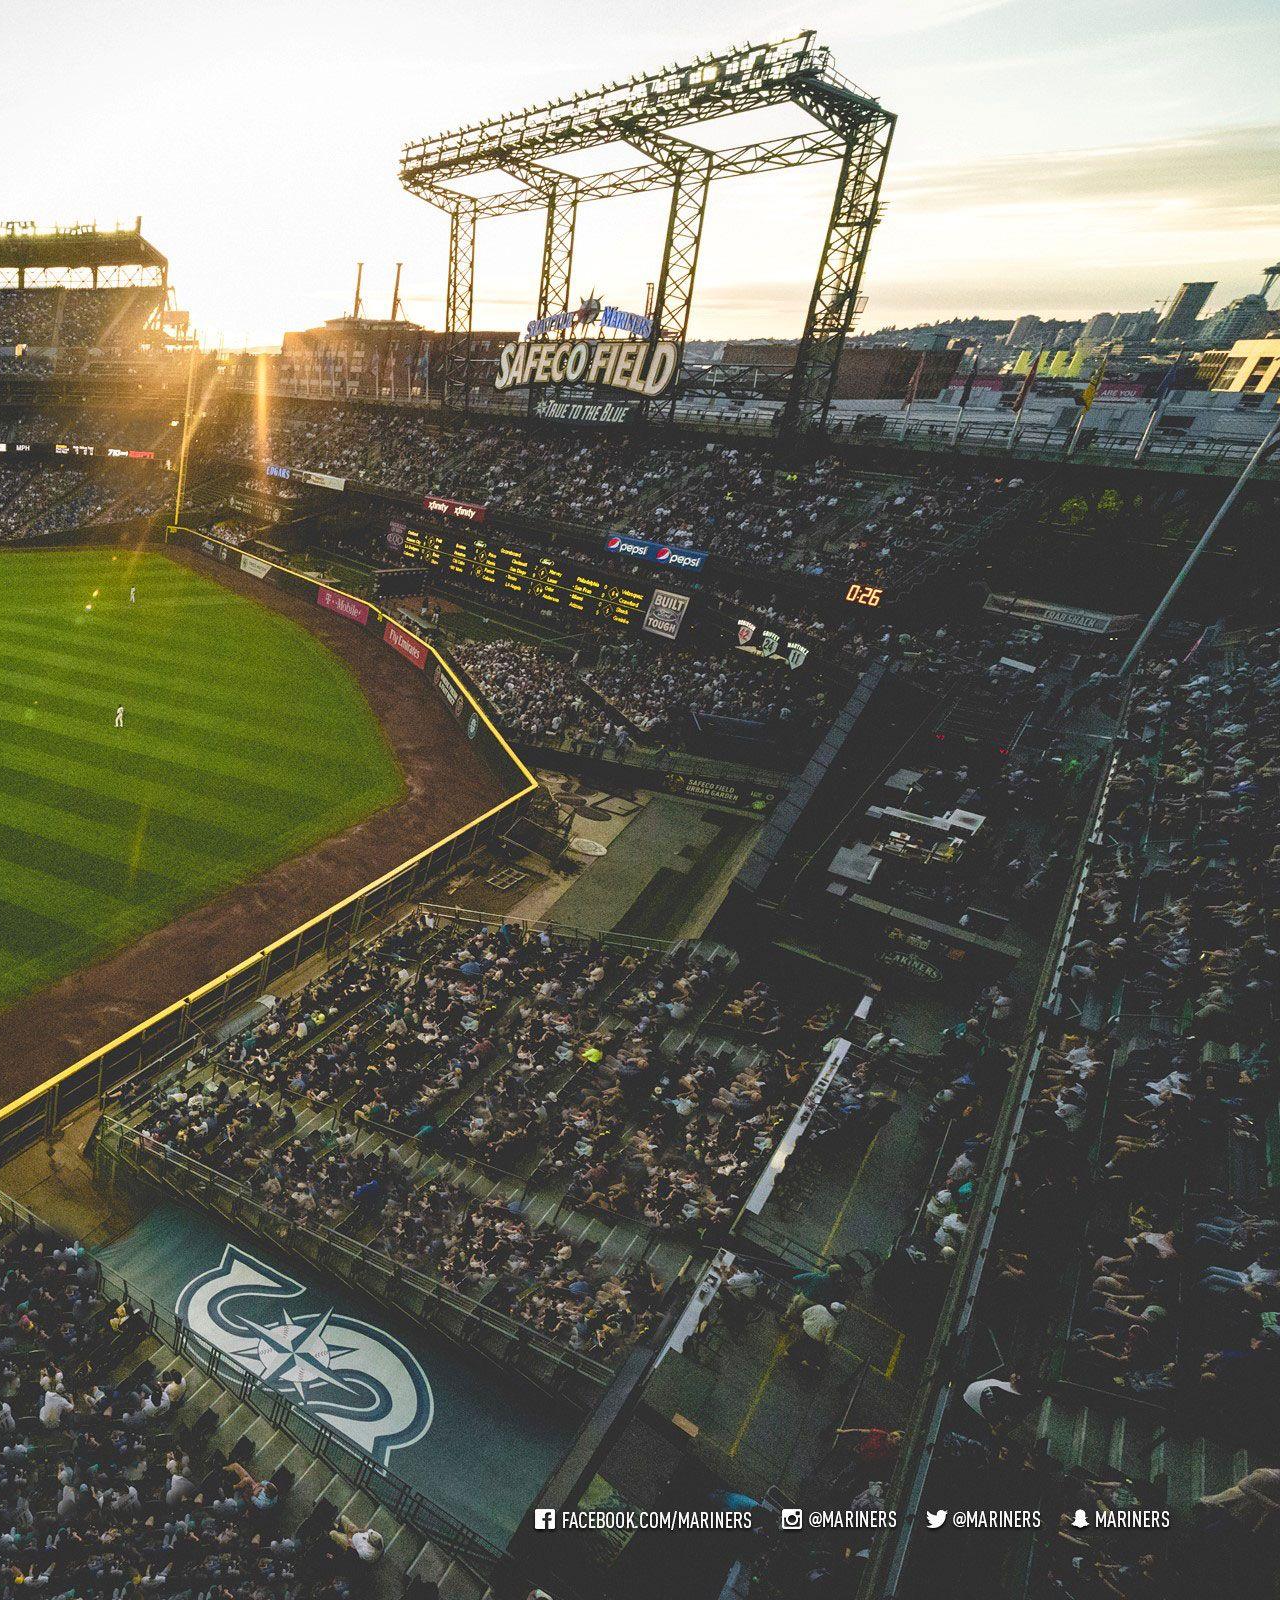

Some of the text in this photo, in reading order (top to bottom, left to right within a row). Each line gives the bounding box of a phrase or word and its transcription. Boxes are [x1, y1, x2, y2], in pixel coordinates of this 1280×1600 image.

[524, 306, 655, 341] SEATTLE MARINERS
[494, 341, 678, 396] SAFECO FIELD
[546, 400, 629, 423] TRUE TO THE BLUE
[129, 450, 155, 459] ESPN
[428, 500, 476, 520] xfinity xfinity
[619, 543, 701, 568] pepsi pepsi
[654, 594, 686, 612] BUILT
[845, 584, 883, 607] 0:26
[657, 610, 677, 621] Ford
[1067, 615, 1097, 628] SHACK
[647, 617, 677, 634] TOUGH
[762, 629, 780, 641] GRIFFEY
[389, 628, 421, 659] Fly Emirates
[764, 639, 775, 651] 24
[787, 642, 810, 655] MARTINEZ
[791, 651, 800, 665] 11
[686, 785, 710, 795] URBAN
[711, 790, 740, 801] GARDEN
[688, 779, 735, 794] SAFECO FIELD
